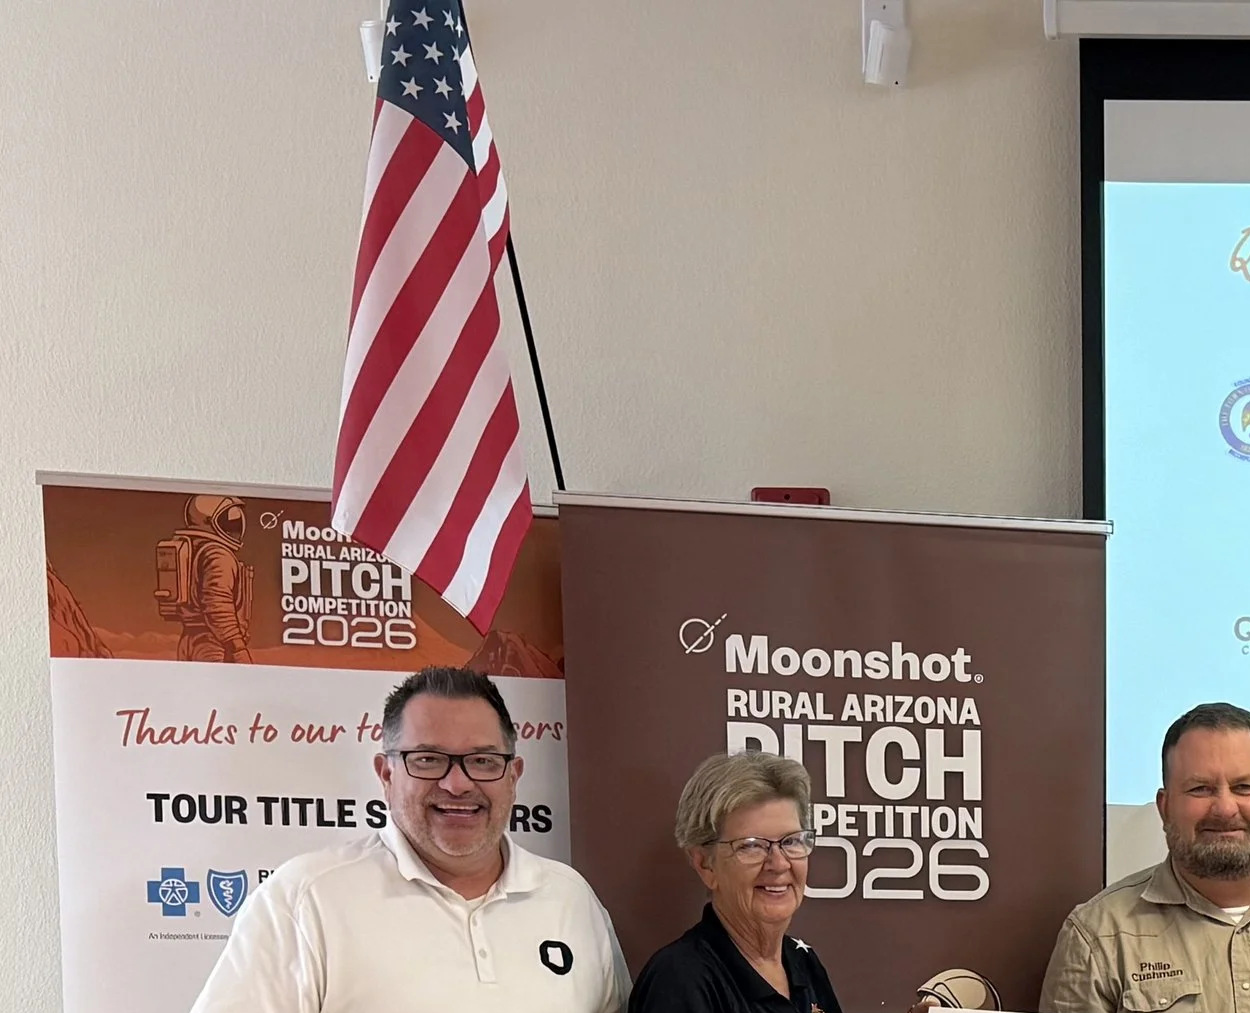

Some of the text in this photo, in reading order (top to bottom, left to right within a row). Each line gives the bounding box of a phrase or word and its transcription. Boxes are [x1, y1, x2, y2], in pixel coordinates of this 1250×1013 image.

[281, 542, 336, 560] RURAL
[281, 558, 413, 601] PITCH
[281, 594, 412, 617] COMPETITION
[282, 613, 417, 650] 2026
[724, 633, 973, 683] Moonshot
[727, 688, 981, 725] RURAL ARIZONA
[116, 707, 238, 747] Thanks
[249, 712, 278, 744] to
[291, 723, 347, 744] our
[357, 712, 384, 743] to
[146, 793, 248, 825] TOUR
[256, 796, 357, 828] TITLE
[811, 803, 983, 839] PETITION
[803, 837, 990, 901] 026
